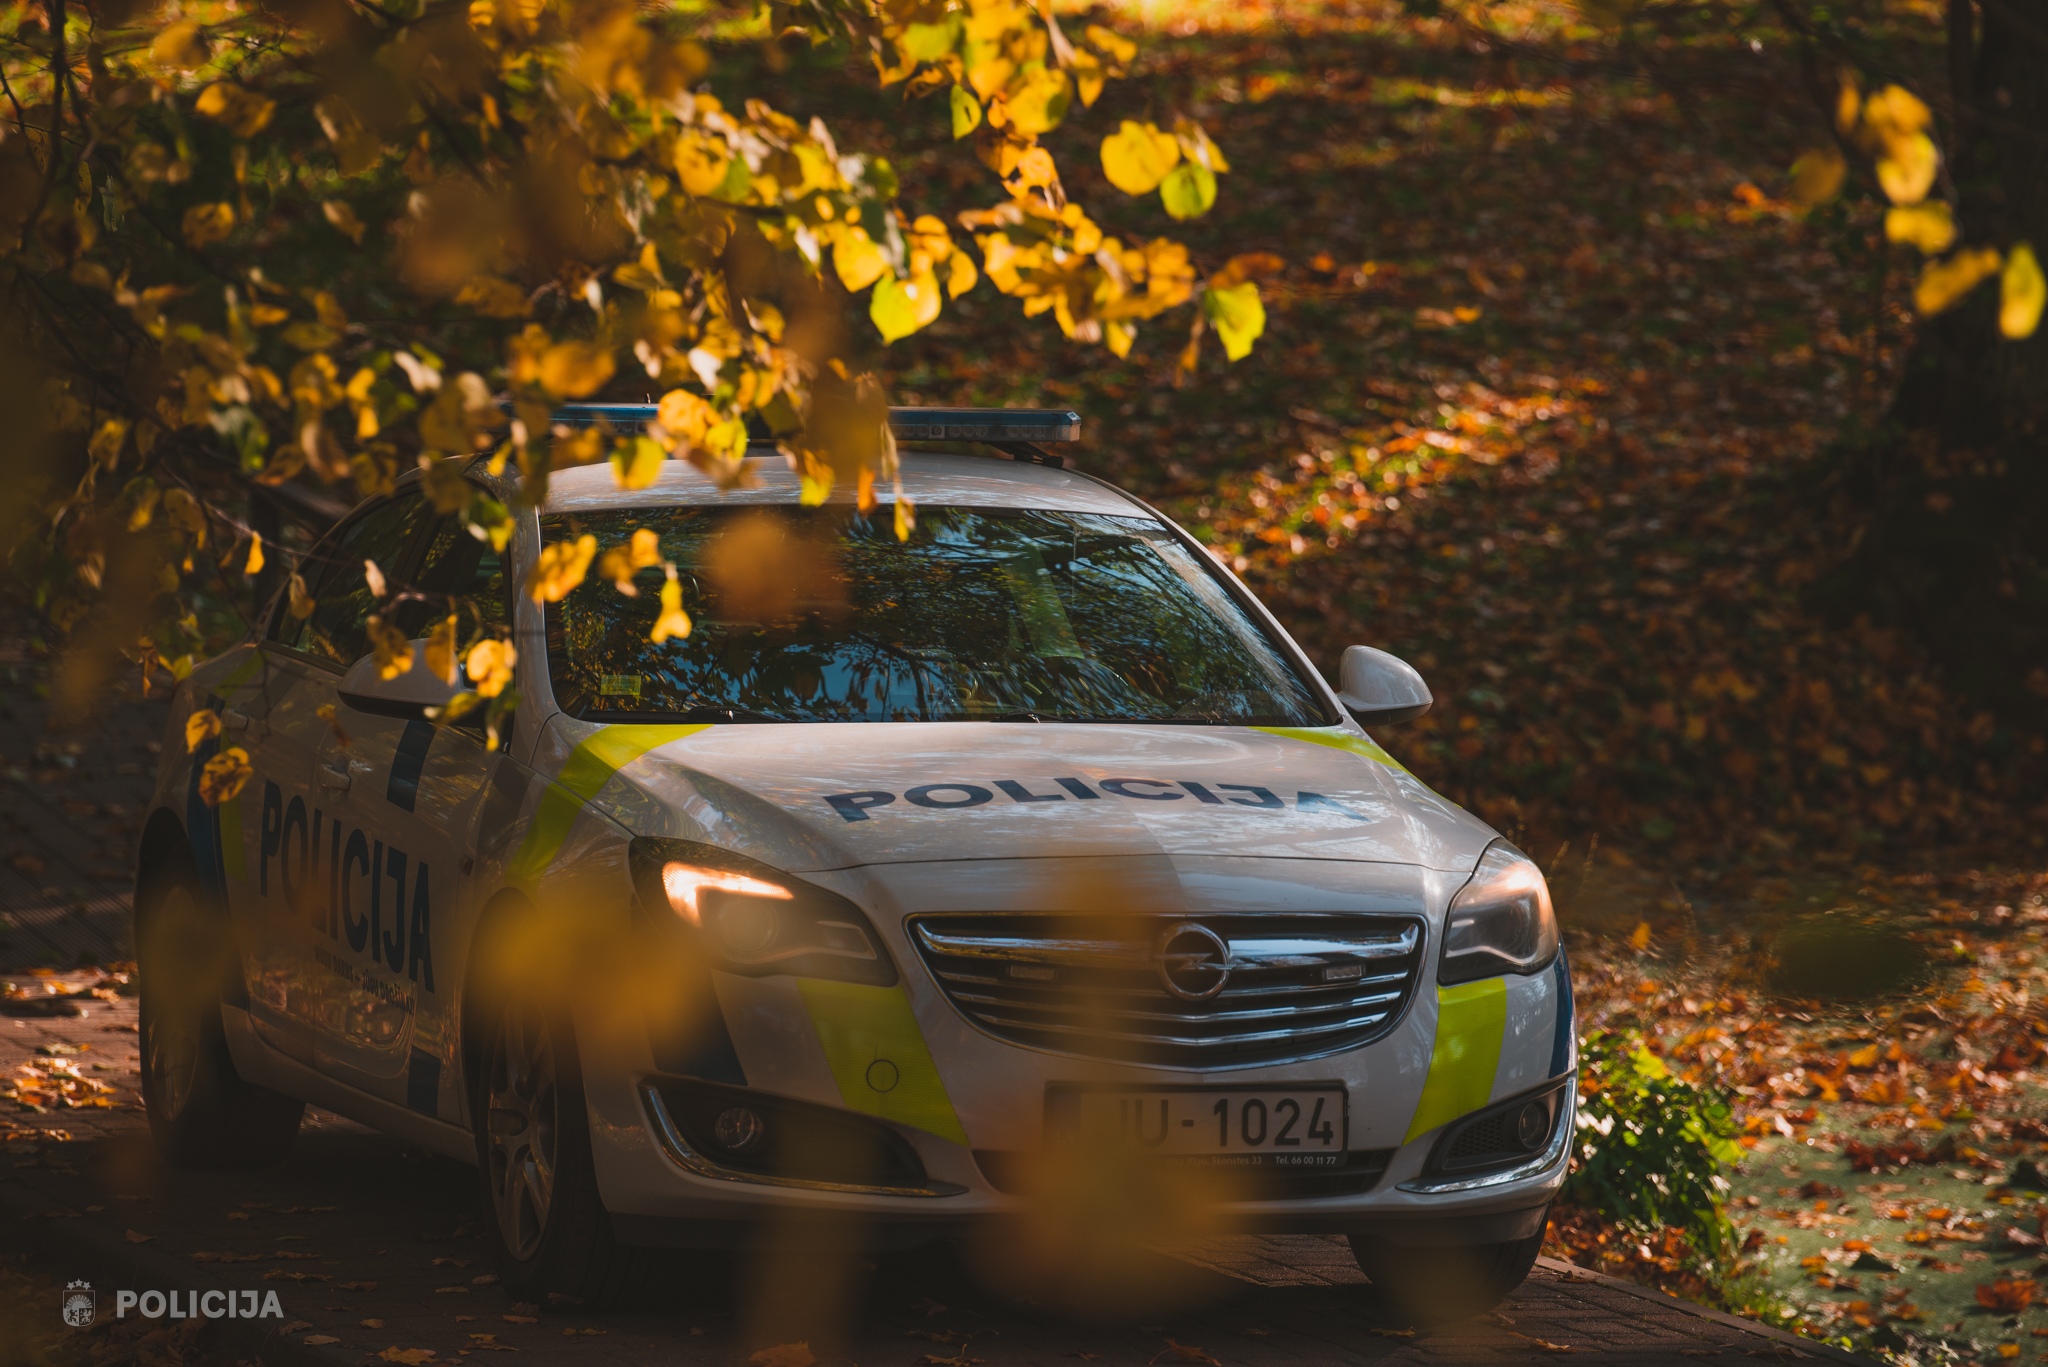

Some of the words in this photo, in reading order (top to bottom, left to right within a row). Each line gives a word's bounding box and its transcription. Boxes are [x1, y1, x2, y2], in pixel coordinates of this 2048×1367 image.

[823, 777, 1371, 823] POLICIJA
[260, 779, 435, 994] POLICIJA
[1211, 1156, 1249, 1165] Skanstes
[1251, 1156, 1262, 1165] 33
[1275, 1156, 1290, 1165] Tel.
[1291, 1156, 1302, 1165] 66
[1303, 1156, 1314, 1165] 00
[1316, 1156, 1324, 1165] 11
[1326, 1156, 1337, 1165] 77
